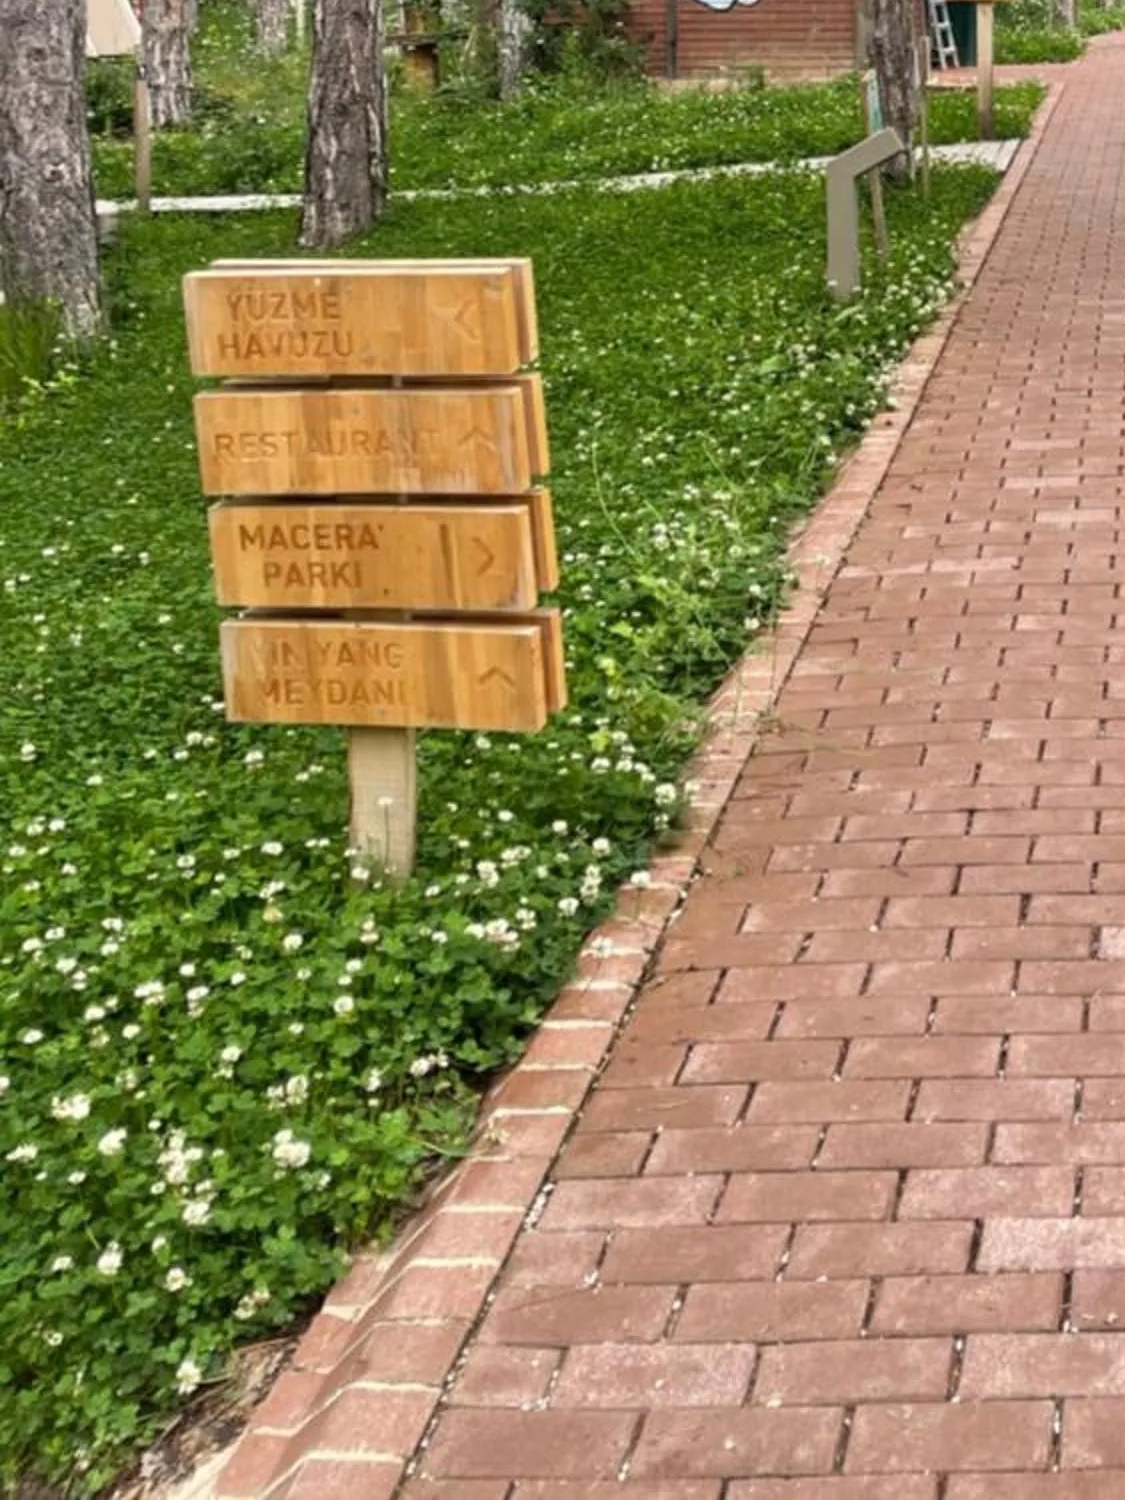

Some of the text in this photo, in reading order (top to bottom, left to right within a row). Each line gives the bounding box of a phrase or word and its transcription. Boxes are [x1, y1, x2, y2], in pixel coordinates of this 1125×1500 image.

[216, 330, 354, 360] HAVUZU
[238, 523, 380, 552] MACERA
[262, 561, 363, 589] PARKI
[314, 641, 404, 668] YANG
